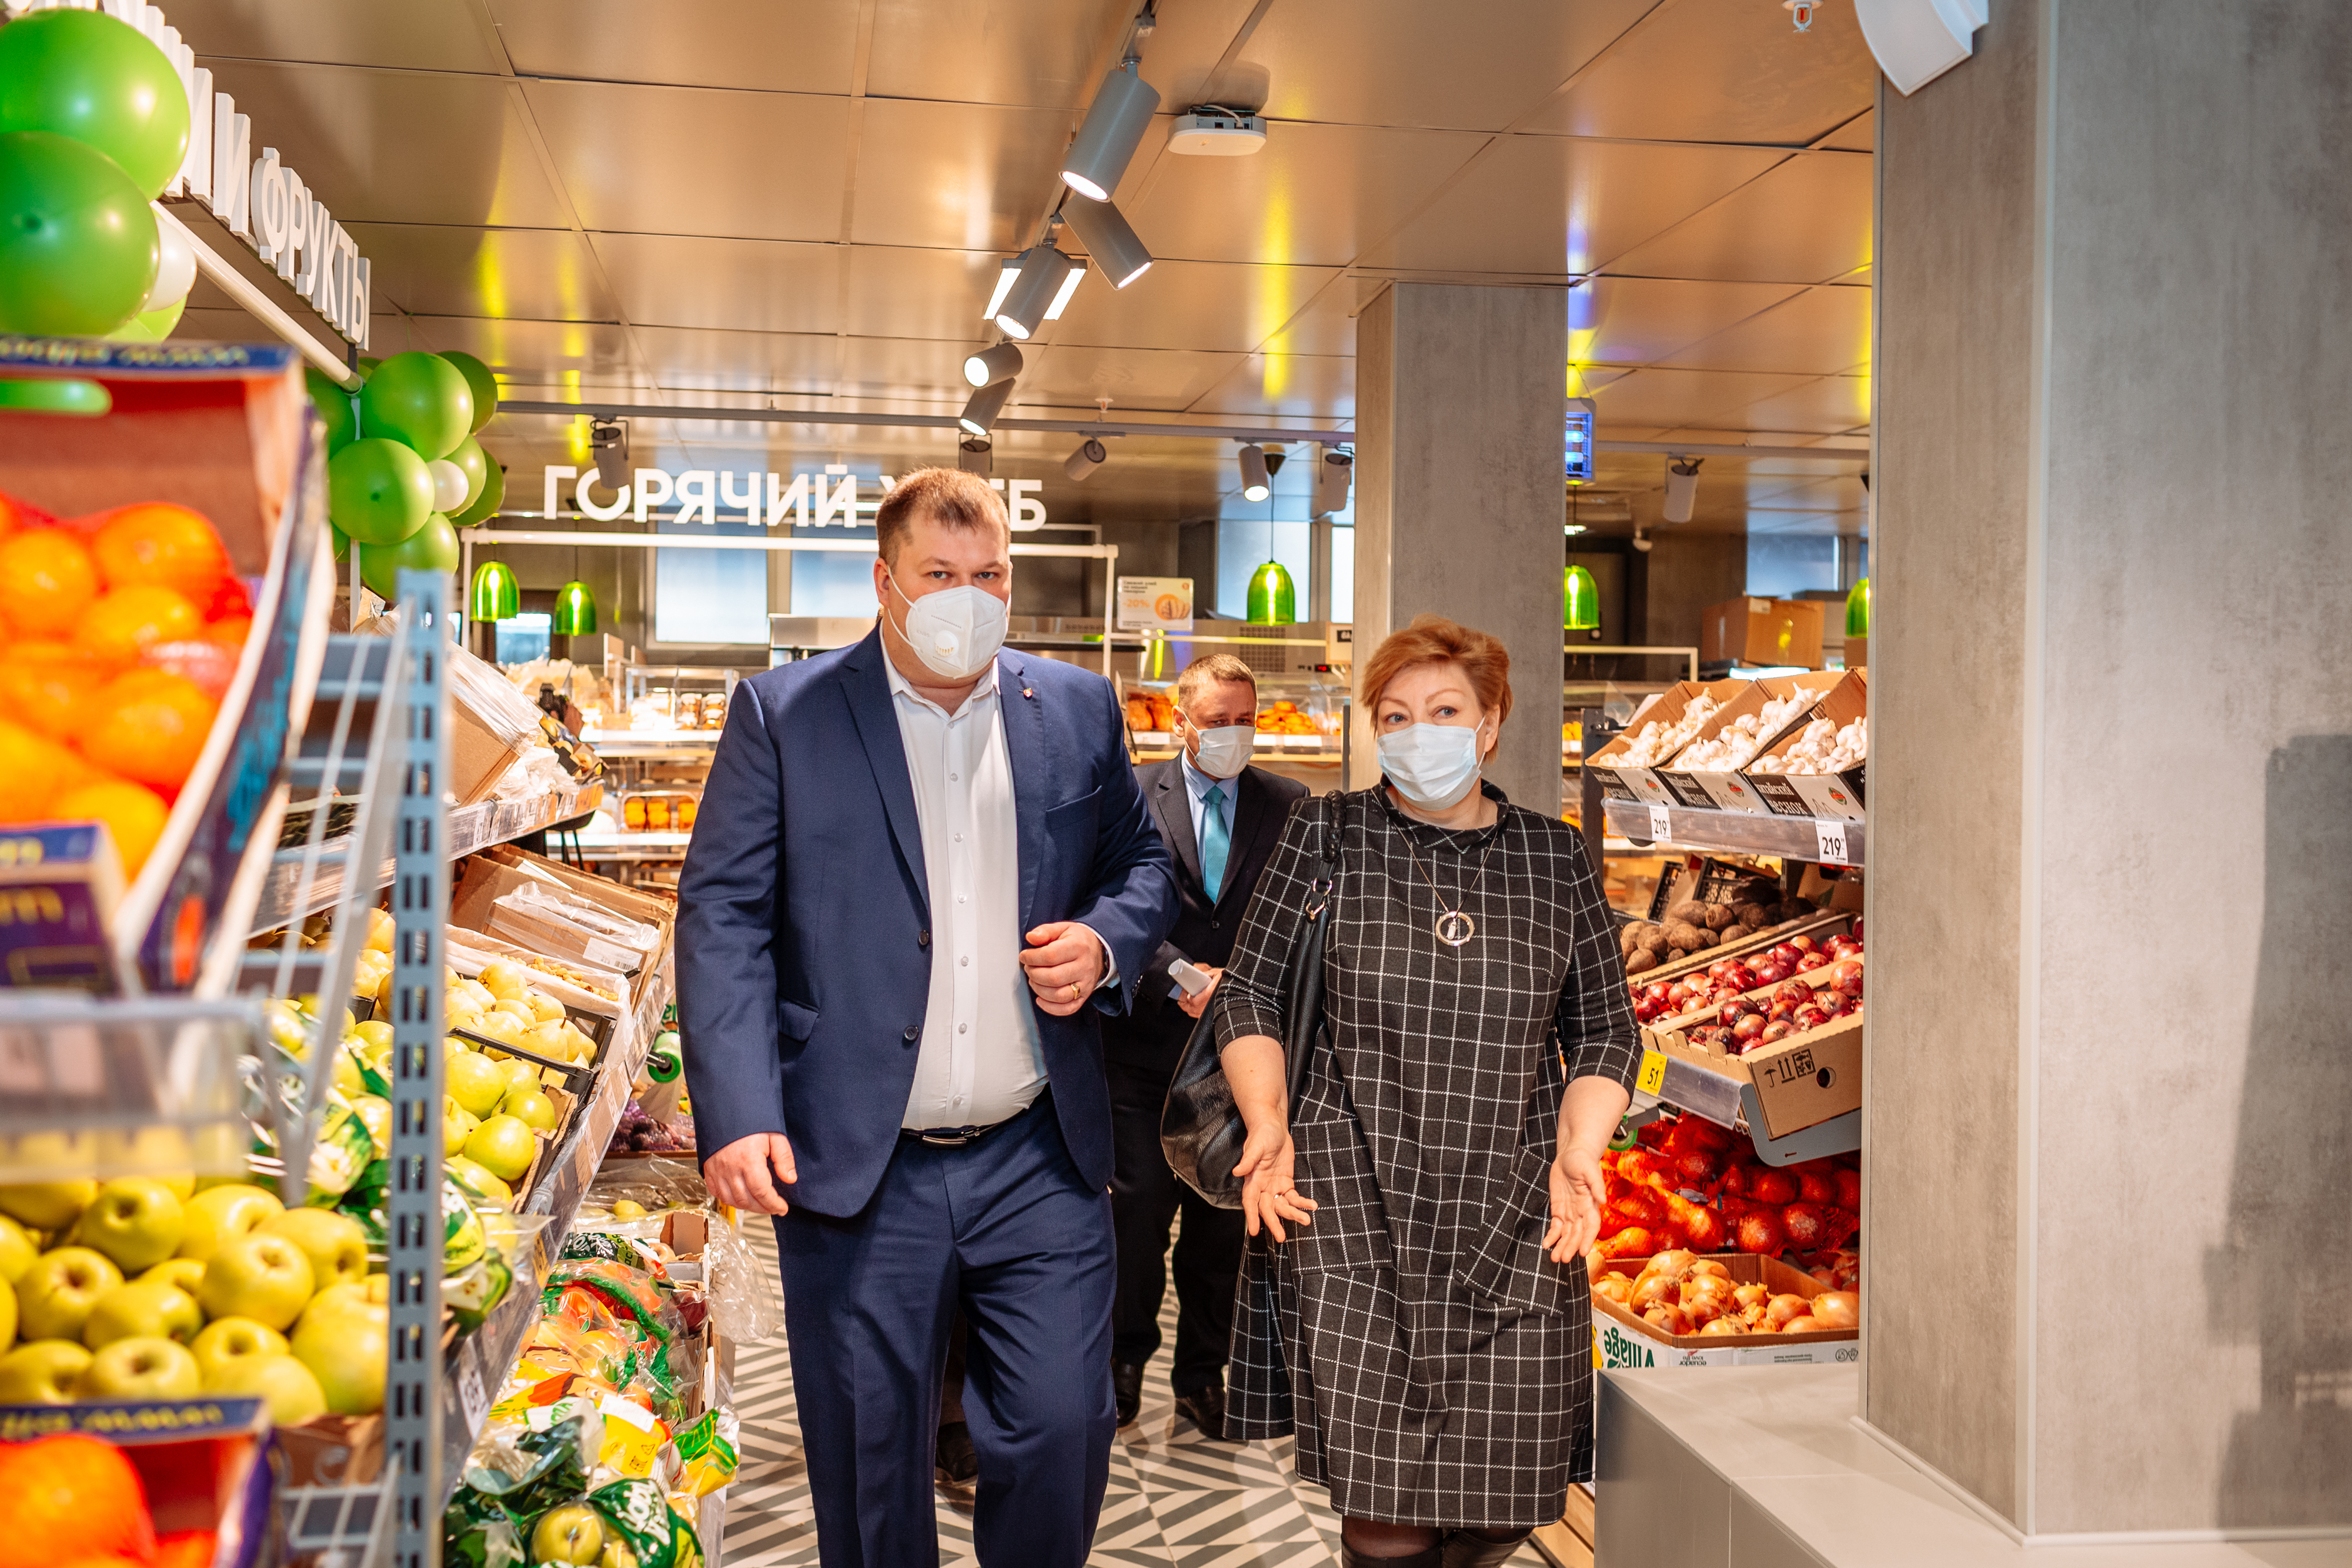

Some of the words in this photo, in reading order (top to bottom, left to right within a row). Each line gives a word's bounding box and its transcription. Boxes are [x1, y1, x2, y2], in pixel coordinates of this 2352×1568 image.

[250, 147, 370, 351] ФРУКТЫ
[544, 464, 857, 528] ГОРЯЧИЙ
[1653, 818, 1667, 835] 219
[1822, 837, 1841, 856] 219
[1647, 1067, 1659, 1086] 51
